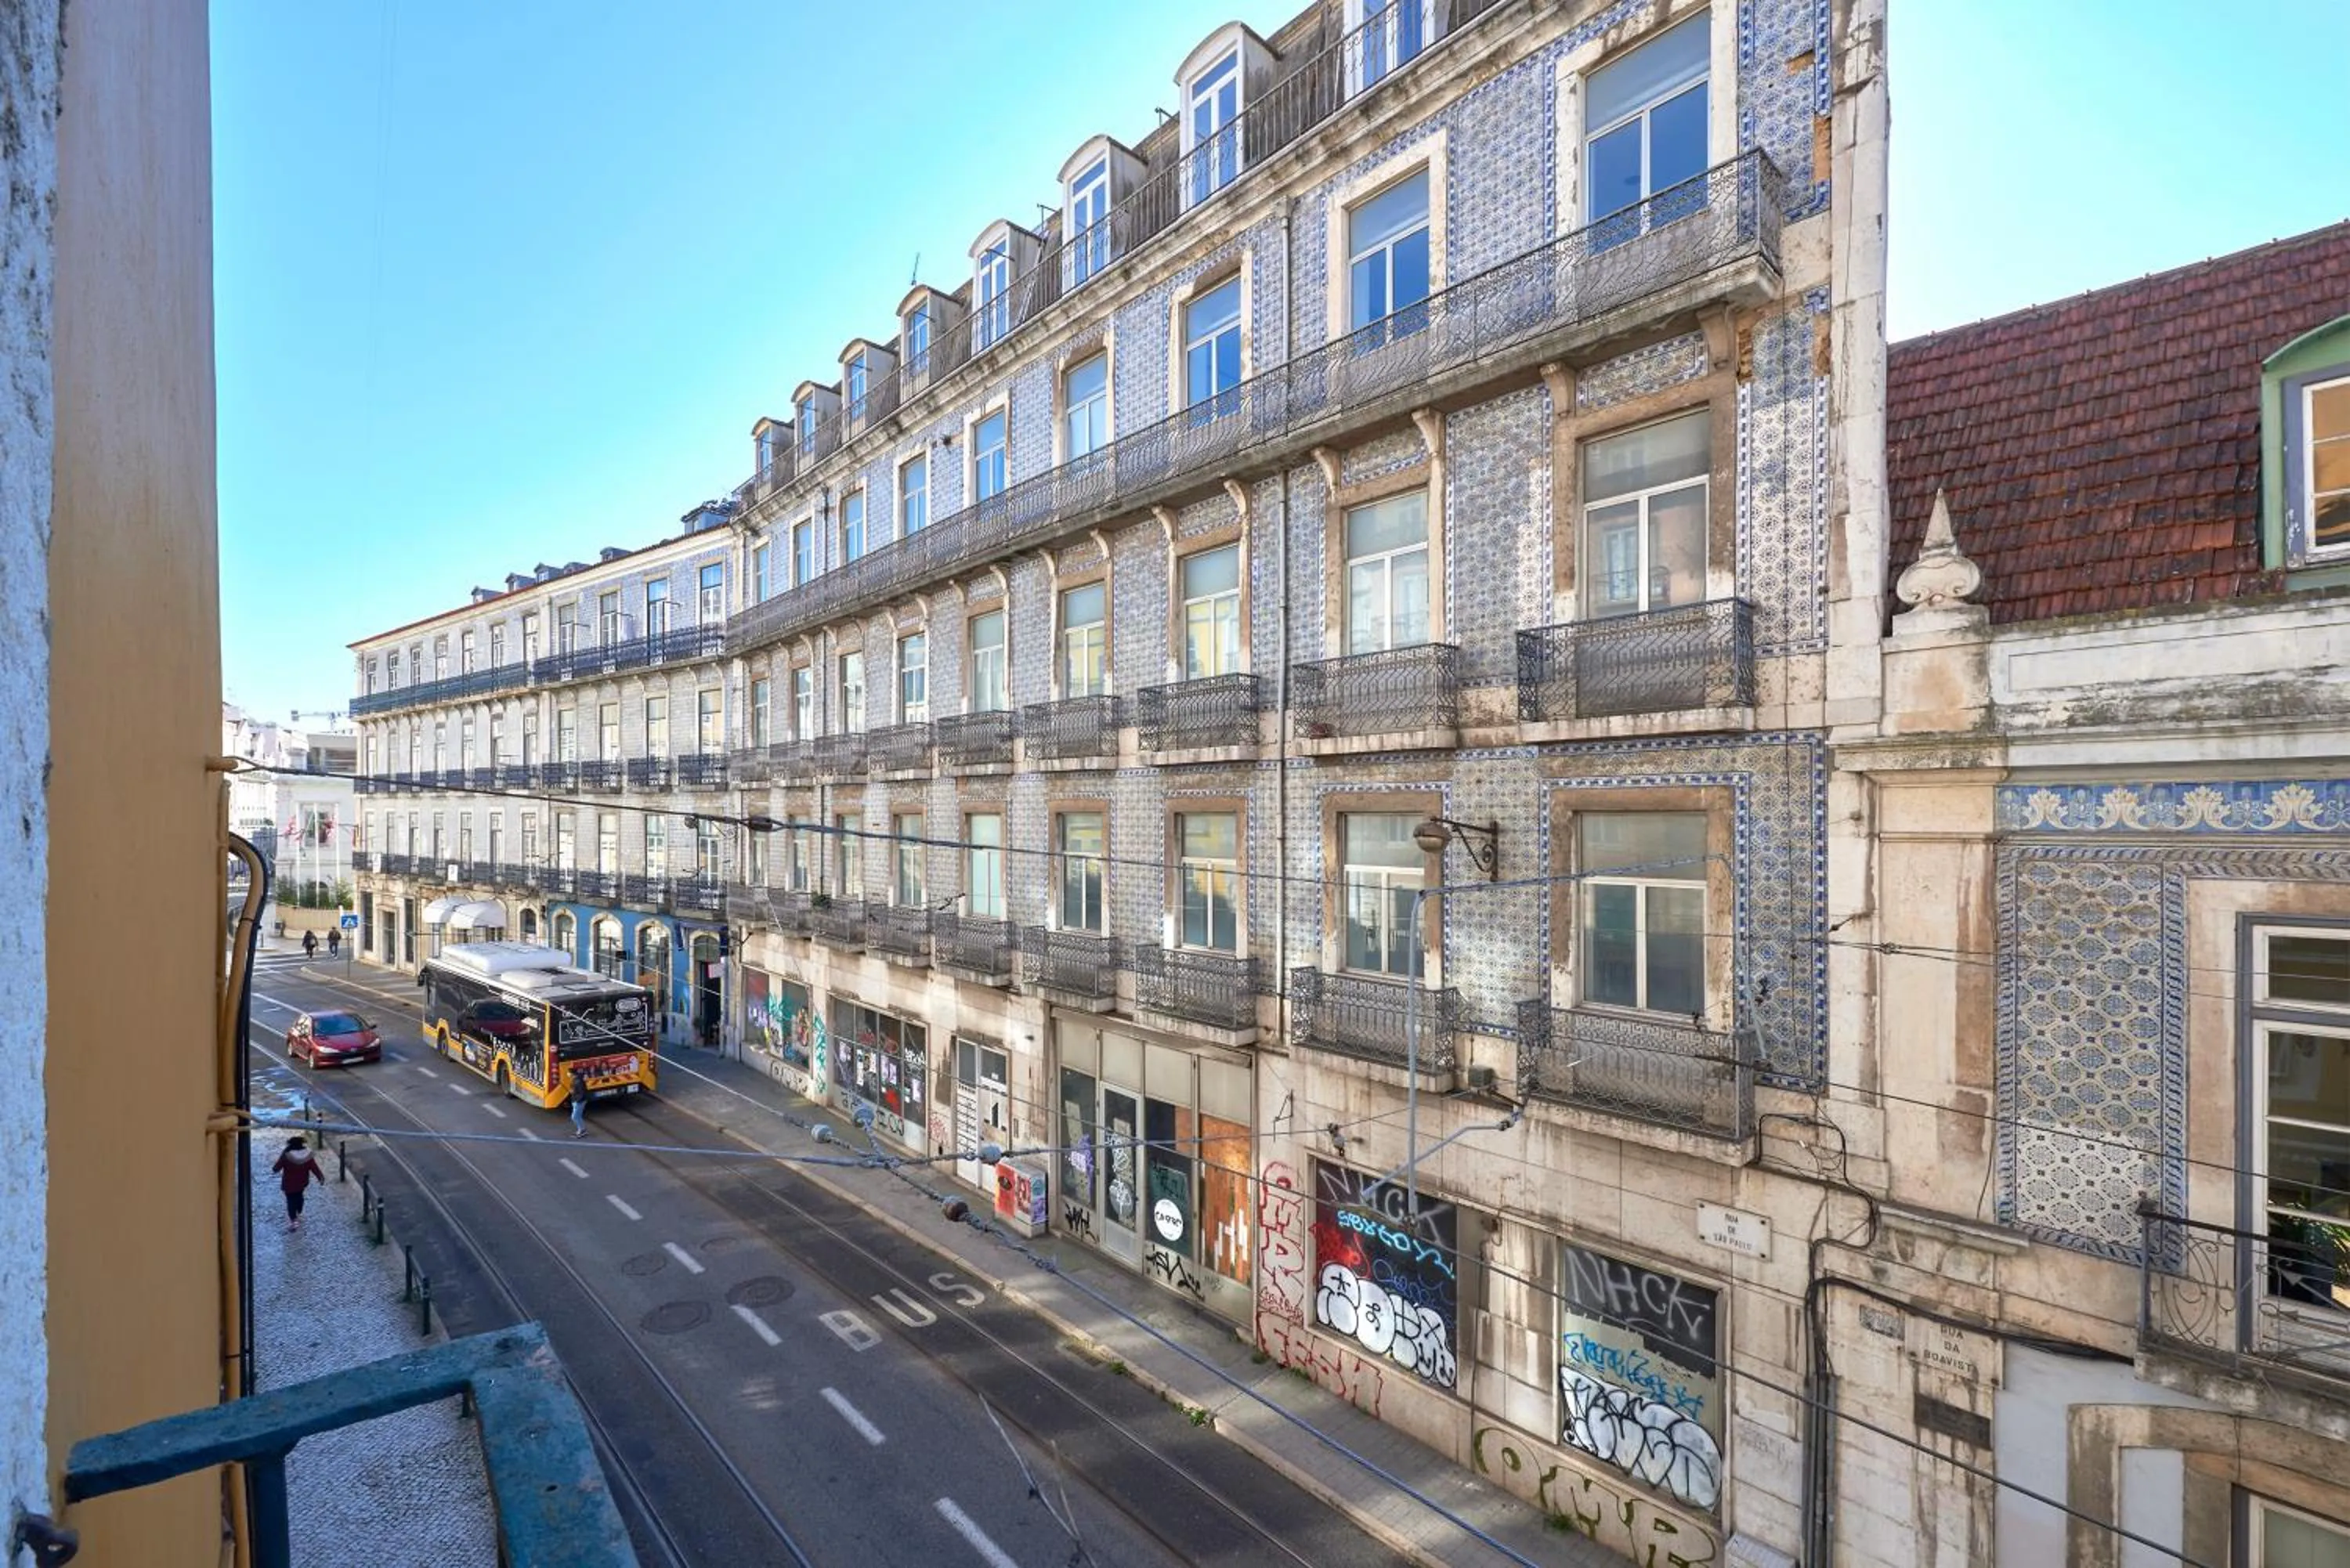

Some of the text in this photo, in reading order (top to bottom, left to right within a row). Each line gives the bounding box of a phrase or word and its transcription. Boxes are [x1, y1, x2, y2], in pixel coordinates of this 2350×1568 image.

[1725, 1213, 1738, 1223] RUA
[818, 1272, 985, 1353] BUS
[1940, 1324, 1964, 1340] RUA
[1944, 1339, 1961, 1354] DA
[1924, 1349, 1979, 1375] BOAVIST
